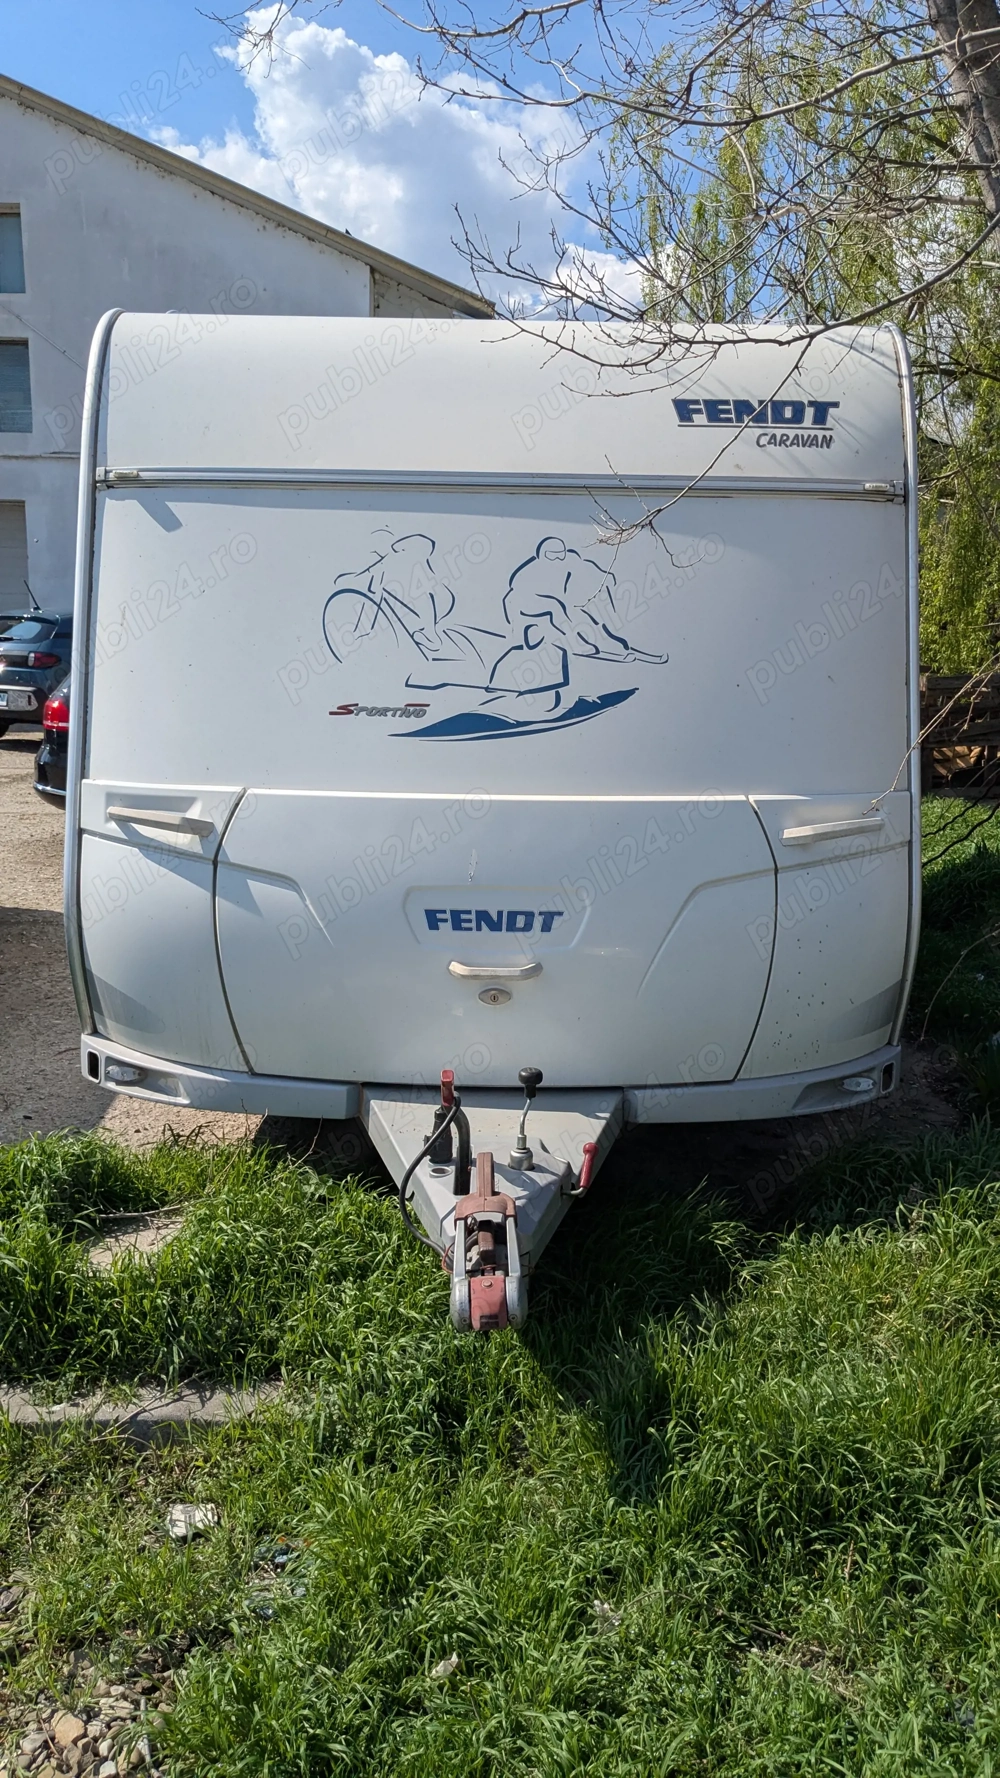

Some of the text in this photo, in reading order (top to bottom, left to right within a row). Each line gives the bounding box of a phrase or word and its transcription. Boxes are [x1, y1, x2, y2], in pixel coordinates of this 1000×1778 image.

[671, 399, 840, 426] FENDT
[756, 432, 834, 449] CARAVAN
[424, 909, 564, 933] FENDT
